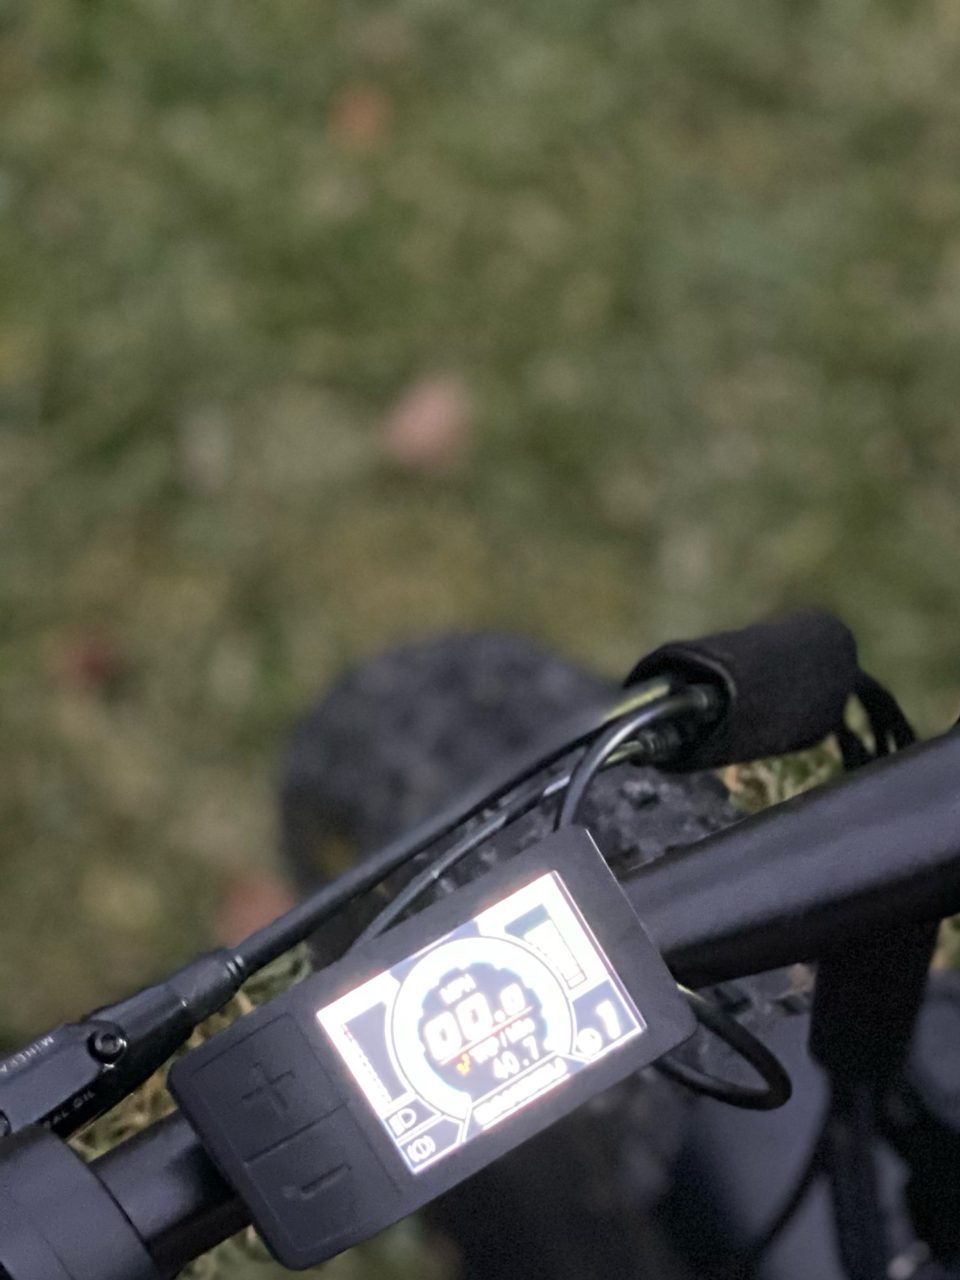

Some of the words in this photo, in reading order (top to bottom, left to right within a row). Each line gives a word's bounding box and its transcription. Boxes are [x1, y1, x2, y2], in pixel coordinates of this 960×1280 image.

[439, 974, 477, 1006] MPH
[424, 982, 527, 1062] 00.0
[595, 999, 622, 1040] 1
[492, 1034, 540, 1080] 40.7
